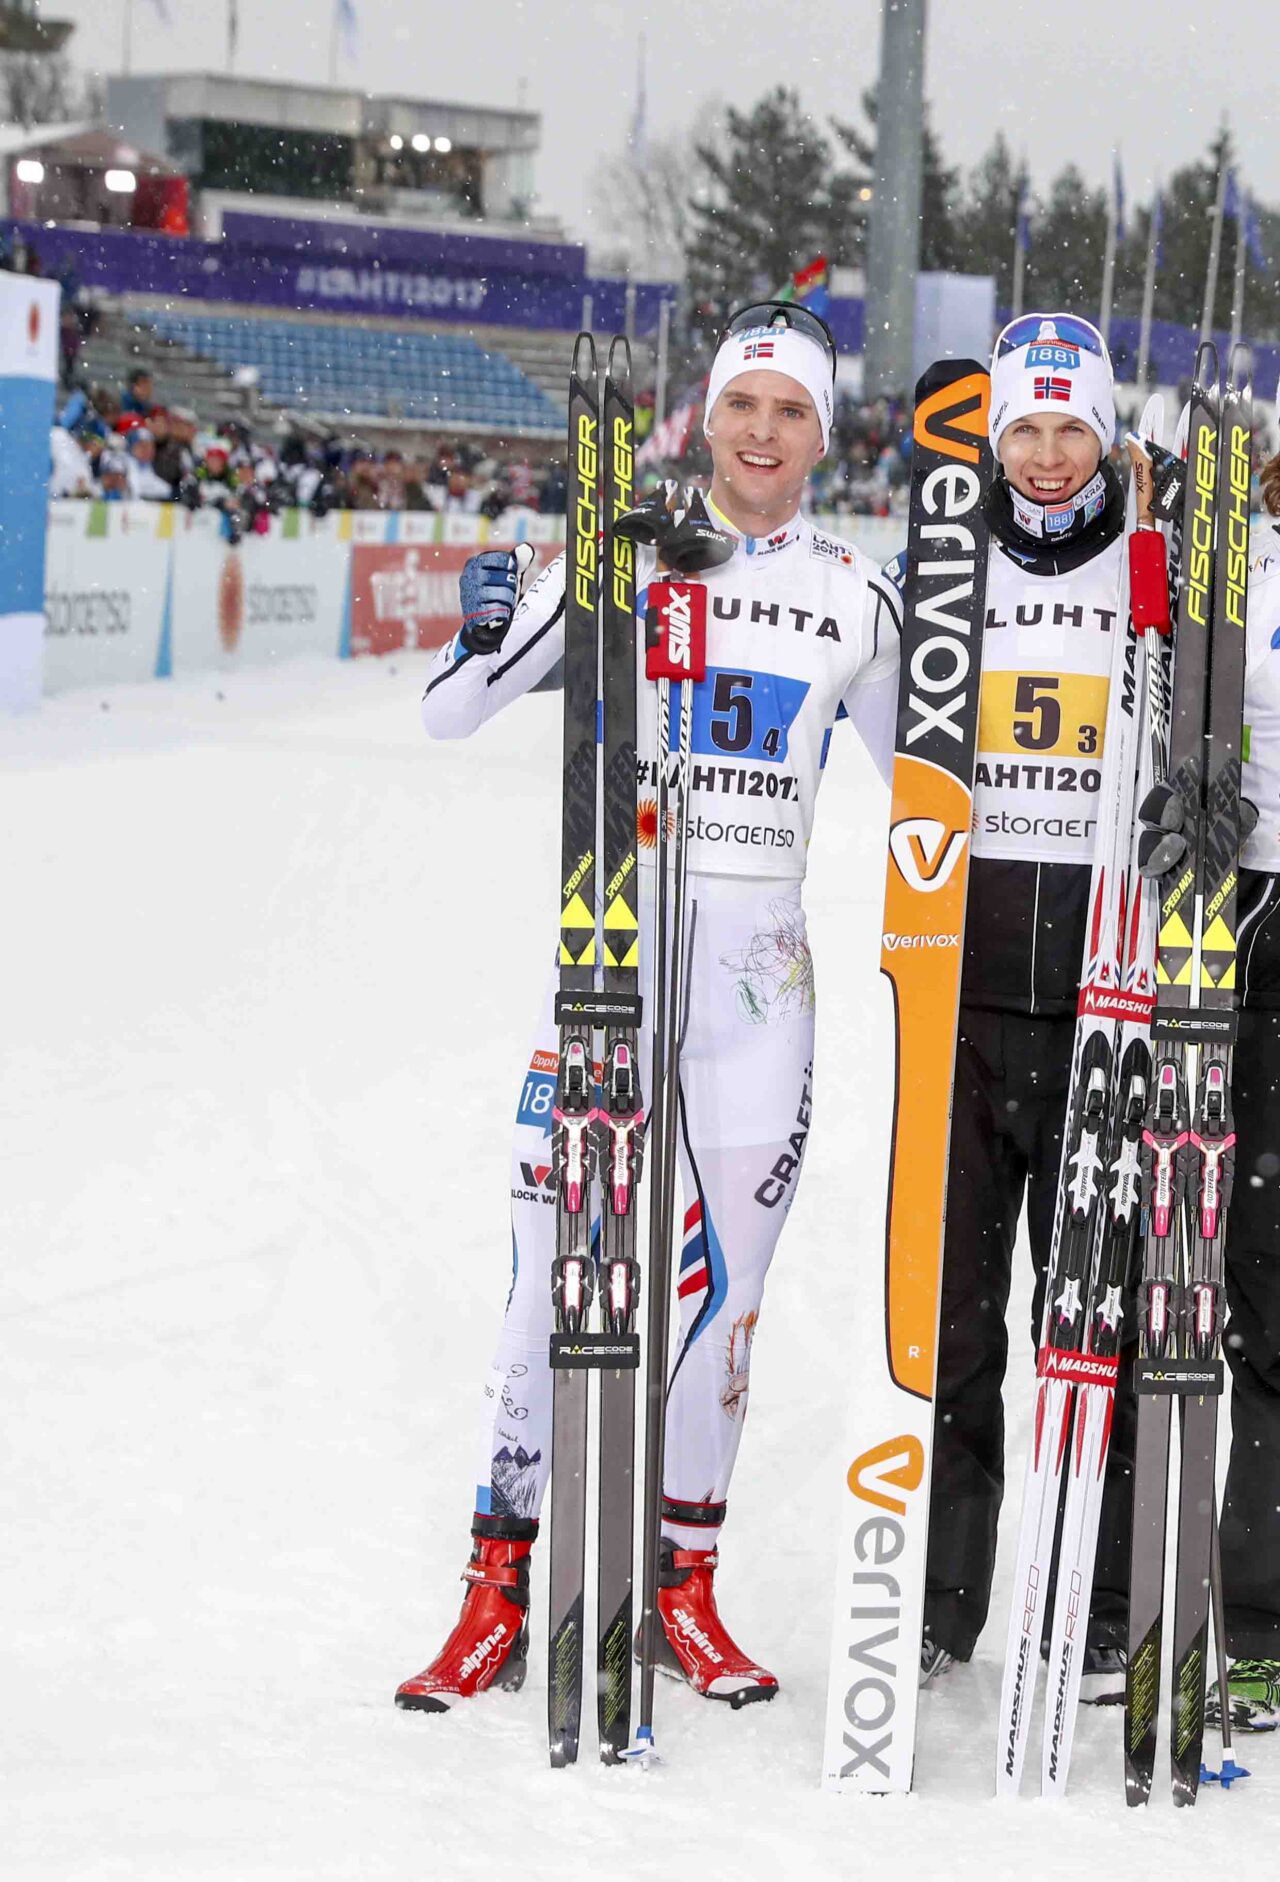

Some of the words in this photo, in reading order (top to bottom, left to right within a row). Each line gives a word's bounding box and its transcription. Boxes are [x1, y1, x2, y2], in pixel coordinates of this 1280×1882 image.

[1031, 348, 1075, 366] 1881
[576, 414, 598, 613] FISCHER
[613, 416, 634, 615] FISHER
[1049, 512, 1072, 527] 1881
[1187, 425, 1218, 626] FISCHER
[1225, 425, 1250, 628] FISCHER
[712, 596, 842, 642] UHTA
[986, 603, 1117, 632] LUHT
[711, 672, 753, 752] 5
[762, 727, 781, 757] 4
[1013, 676, 1061, 750] 5
[1077, 725, 1097, 754] 3
[975, 763, 1102, 793] AHTI20
[562, 869, 582, 899] SPEED
[578, 850, 595, 877] MAX
[605, 871, 624, 900] SPEED
[619, 851, 636, 879] MAX
[1162, 888, 1182, 918] SPEED
[1178, 868, 1196, 896] MAX
[1205, 891, 1225, 921] SPEED
[1220, 870, 1238, 900] MAX
[1097, 994, 1153, 1015] MADSHU
[521, 1080, 554, 1114] 18
[753, 1083, 813, 1209] CRAFT
[909, 1345, 919, 1359] R
[1058, 1356, 1117, 1378] MADSHU
[459, 1623, 508, 1679] alpina
[671, 1608, 724, 1664] alpina
[1006, 1635, 1028, 1778] MADSHUS
[1049, 1640, 1070, 1783] MADSHUS
